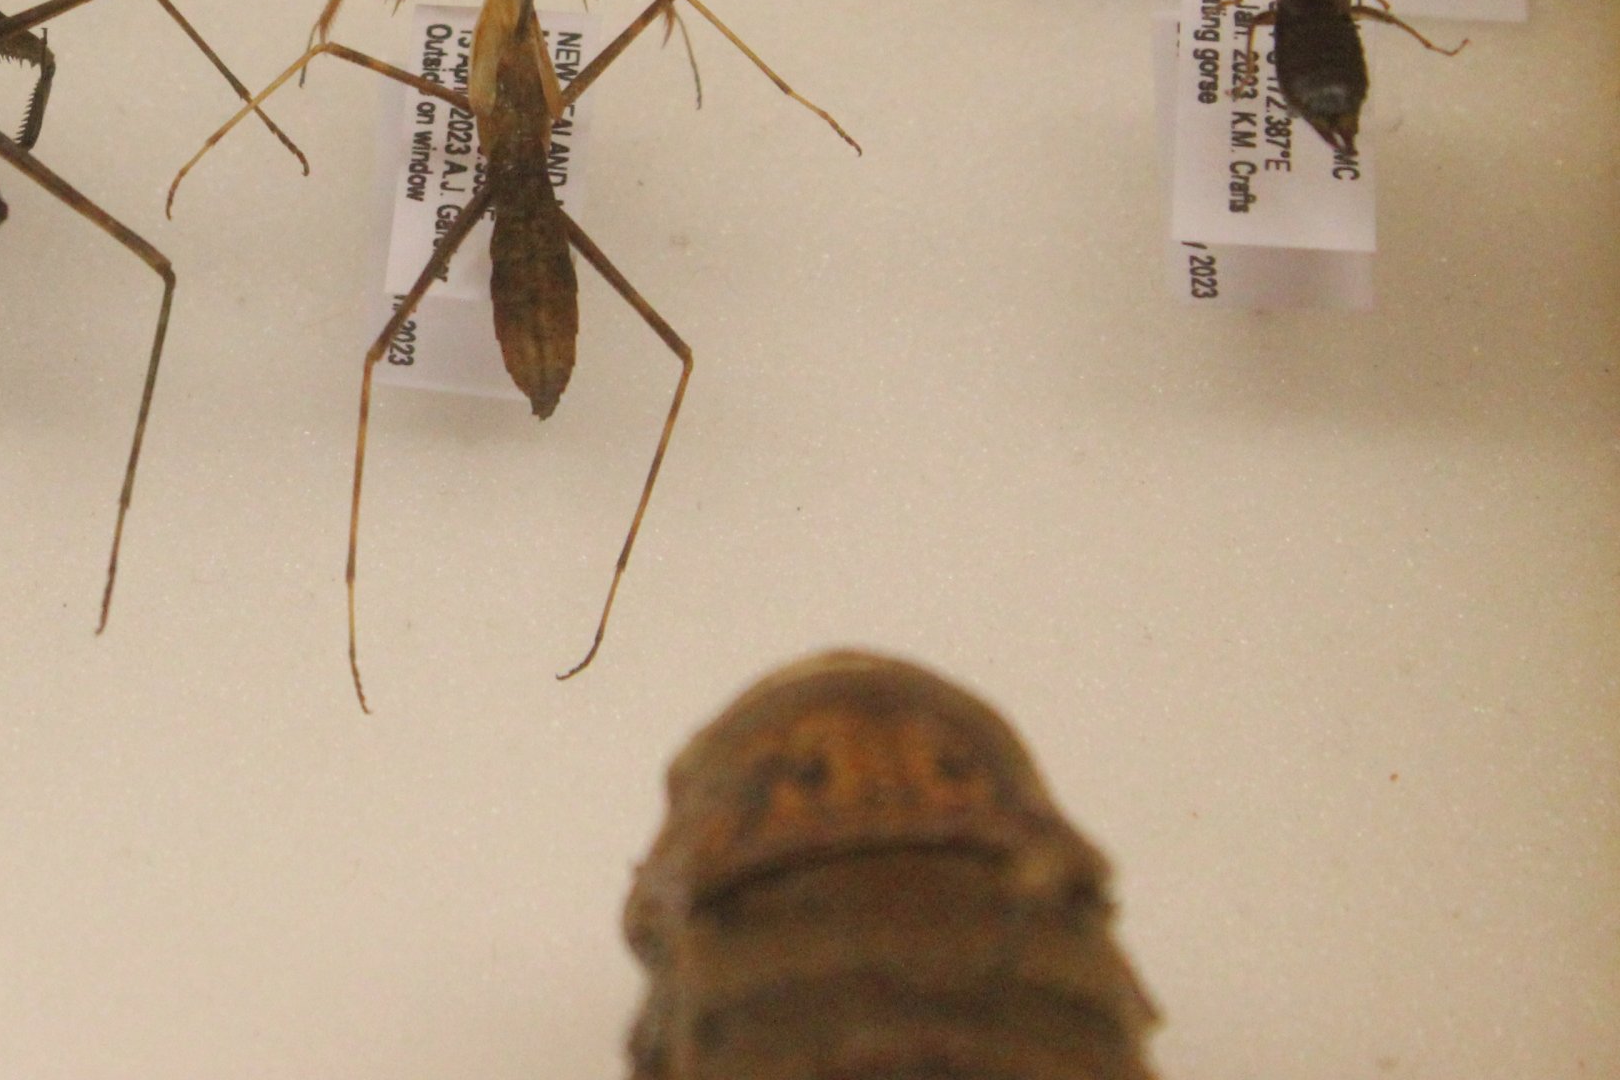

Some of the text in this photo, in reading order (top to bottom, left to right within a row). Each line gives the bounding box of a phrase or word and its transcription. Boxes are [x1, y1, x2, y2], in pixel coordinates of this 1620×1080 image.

[1193, 48, 1220, 104] gorse
[406, 23, 453, 202] Outsid on window
[444, 106, 475, 156] 2023
[1189, 255, 1218, 299] 2023
